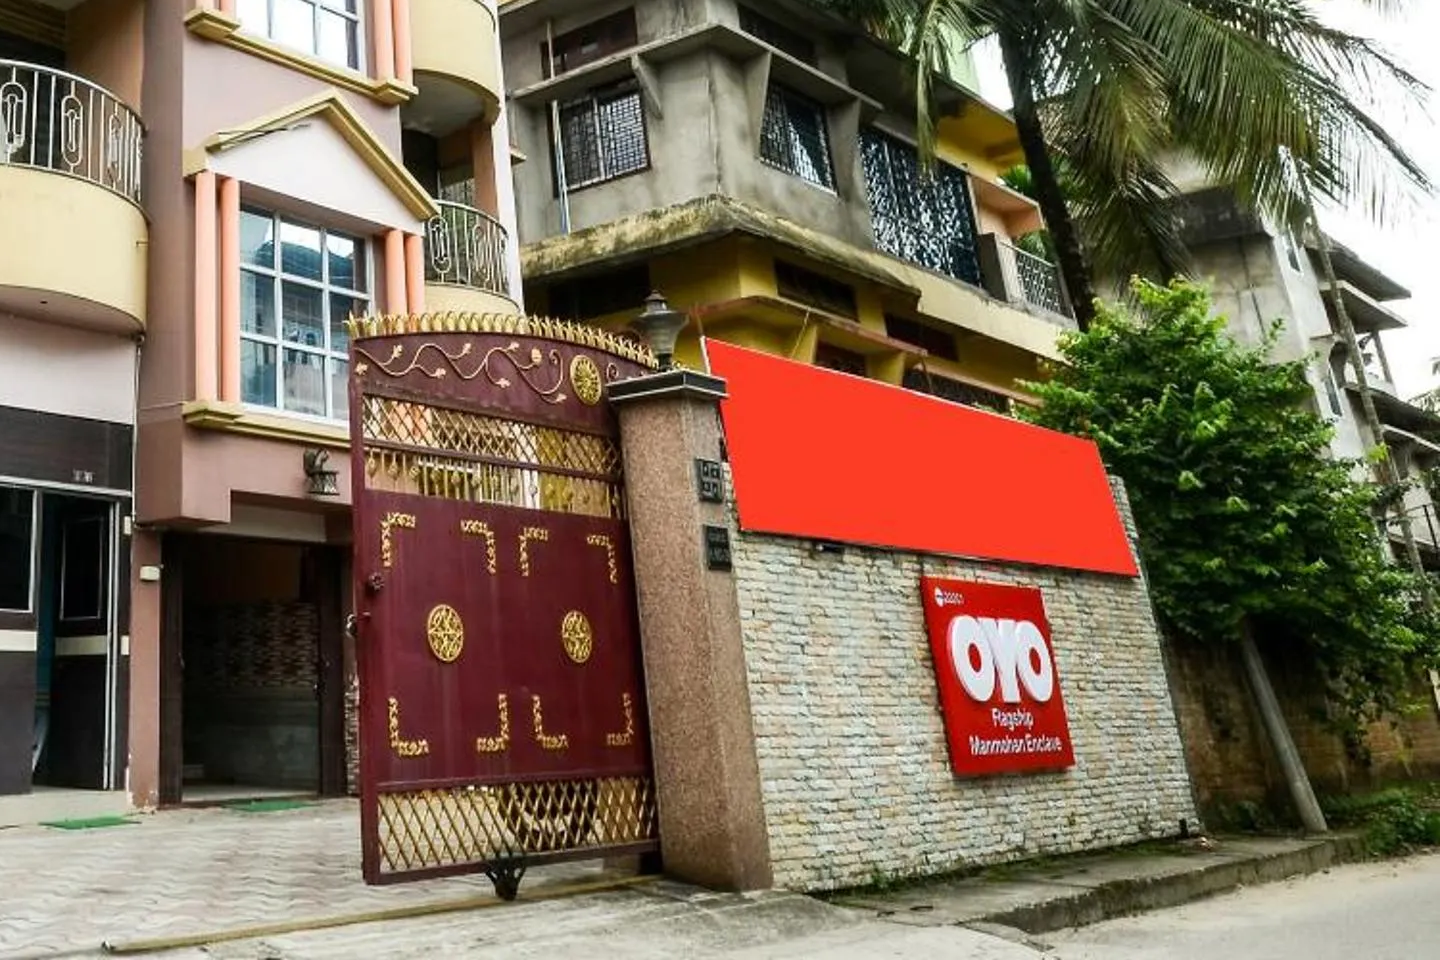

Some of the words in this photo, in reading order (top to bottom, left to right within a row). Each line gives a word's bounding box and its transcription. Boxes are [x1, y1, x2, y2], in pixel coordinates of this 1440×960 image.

[947, 615, 1053, 703] OYO
[991, 707, 1034, 731] Flagship
[969, 735, 1025, 755] Manmohan
[1025, 733, 1063, 753] Enclave
